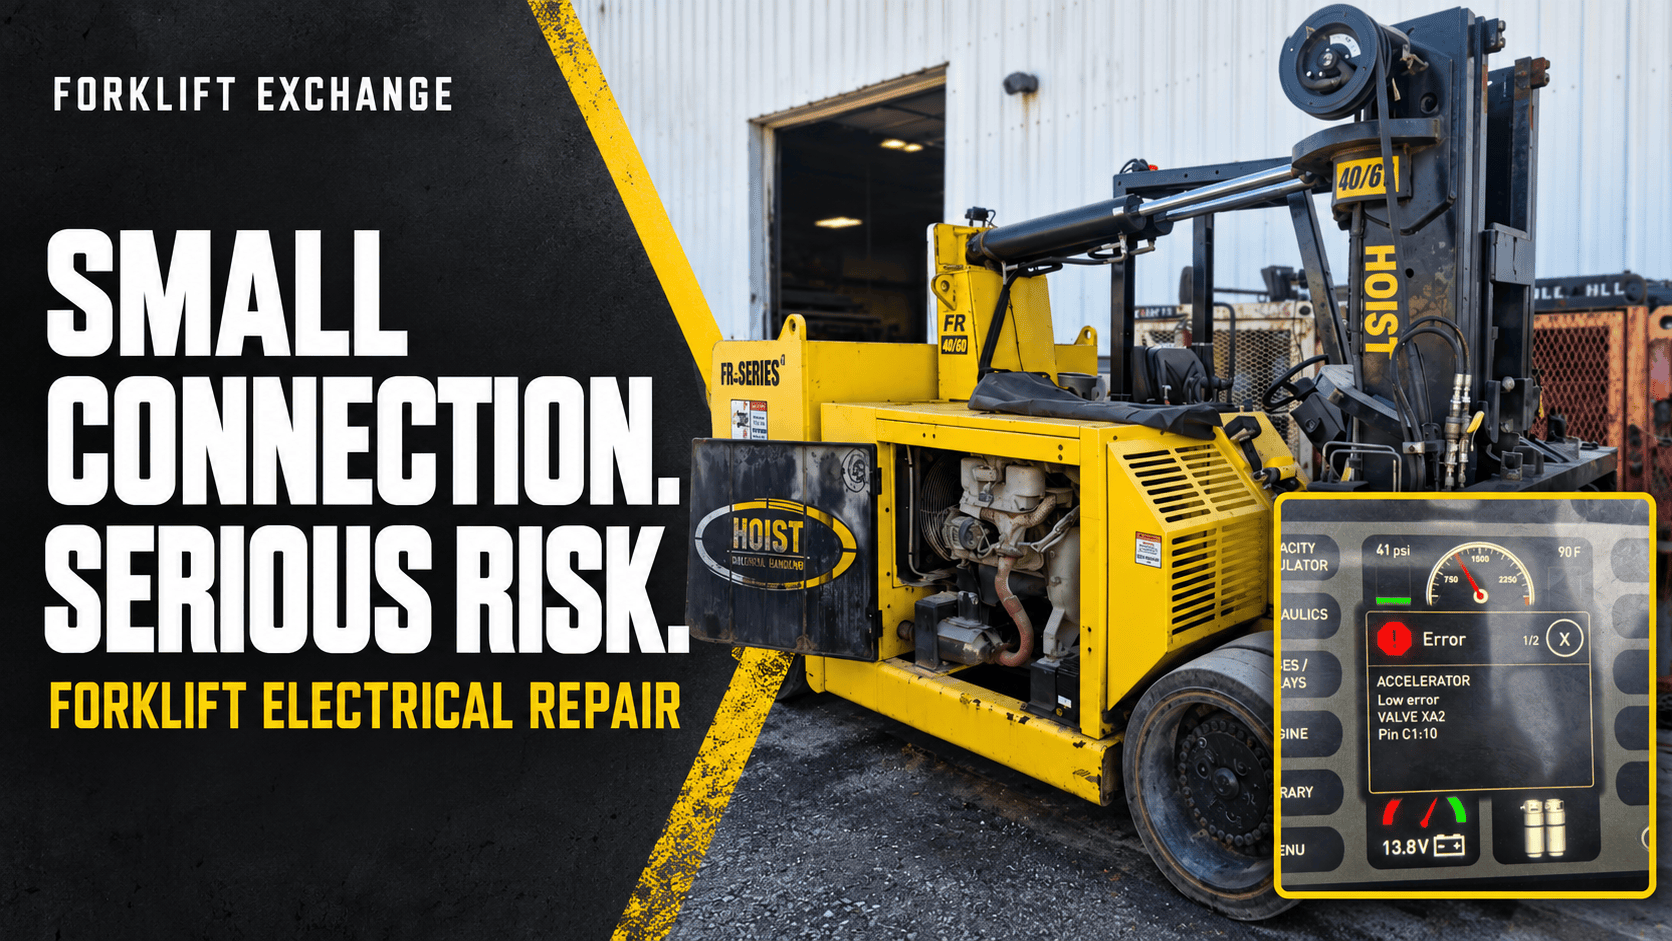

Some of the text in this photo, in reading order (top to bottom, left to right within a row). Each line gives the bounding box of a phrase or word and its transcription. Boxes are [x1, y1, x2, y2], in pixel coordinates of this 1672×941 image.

[1339, 163, 1386, 191] 40/6
[1364, 245, 1399, 360] HOIST
[943, 314, 966, 332] FR
[942, 338, 967, 353] 40/60
[733, 517, 804, 553] HOIST
[1281, 542, 1316, 554] ACITY
[1376, 544, 1411, 558] 41 psi
[1471, 555, 1490, 563] 1500
[1499, 576, 1517, 584] 2250
[1281, 608, 1328, 620] AULICS
[1423, 631, 1466, 646] Error
[1523, 635, 1540, 646] 1/2
[1559, 632, 1570, 646] X
[1281, 659, 1300, 672] ES
[1281, 676, 1307, 688] AYS
[1376, 675, 1471, 687] ACCELERATOR
[1378, 694, 1440, 706] Low error
[1378, 711, 1446, 722] VALVE XA2
[1378, 727, 1438, 740] Pin C1:10
